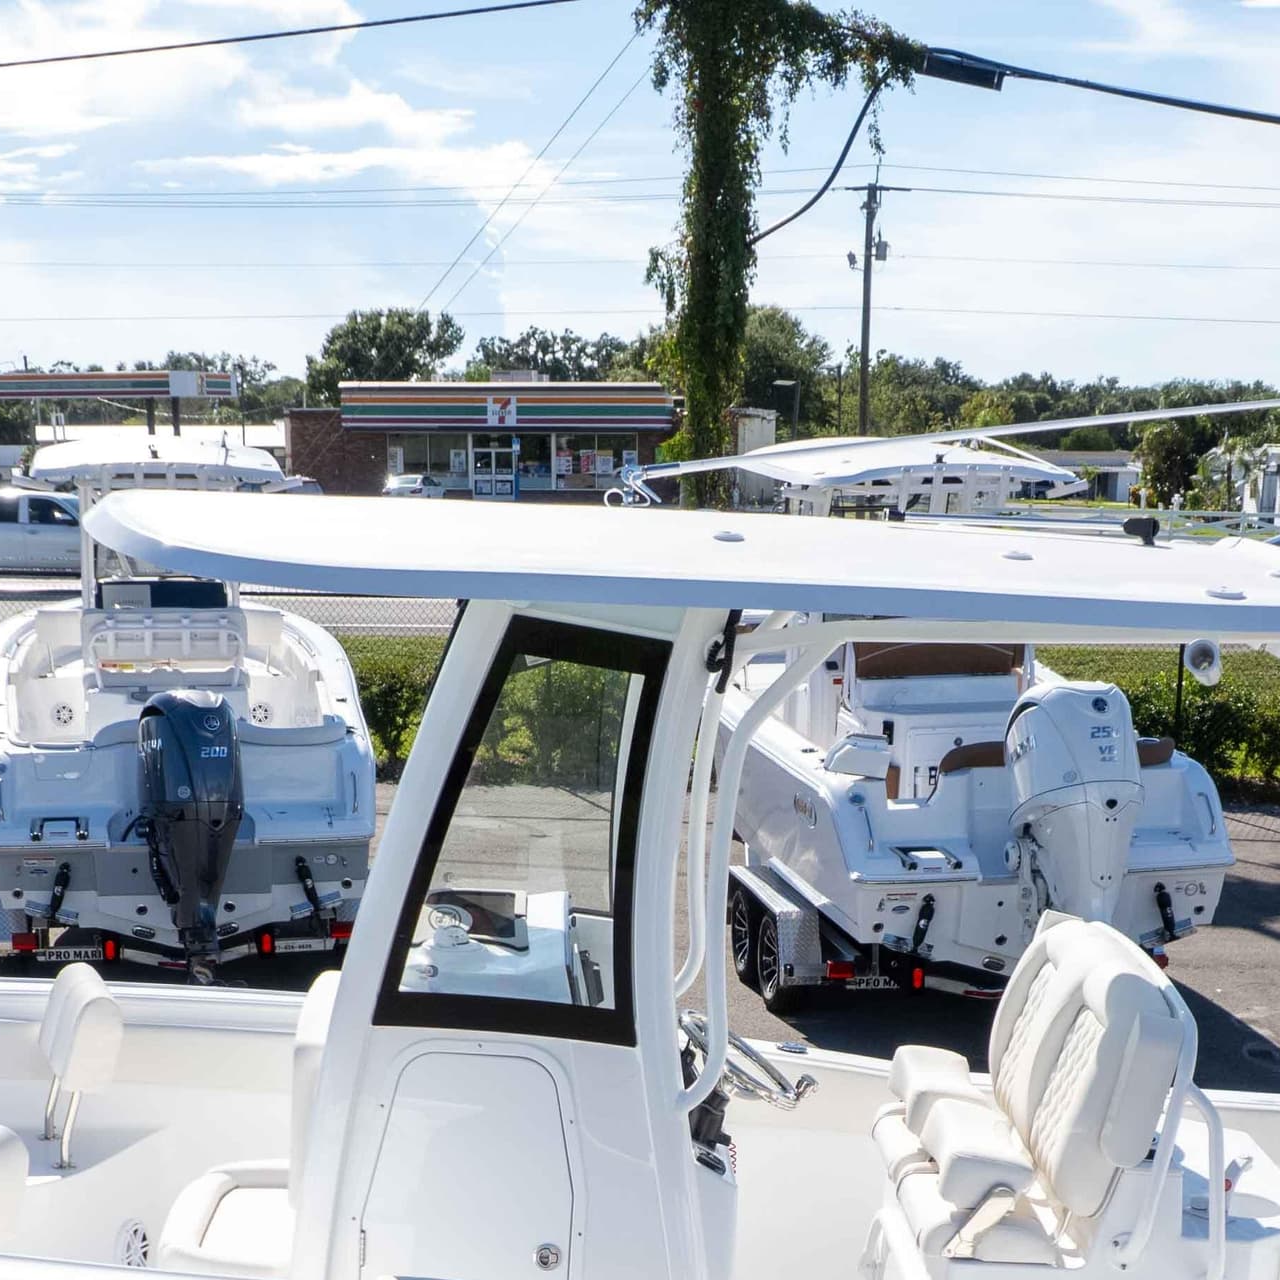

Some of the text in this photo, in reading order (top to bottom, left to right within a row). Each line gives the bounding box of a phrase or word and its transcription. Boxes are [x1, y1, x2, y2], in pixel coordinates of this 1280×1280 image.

[492, 397, 511, 424] 7
[201, 746, 228, 758] 200
[47, 951, 102, 960] PRO MARI
